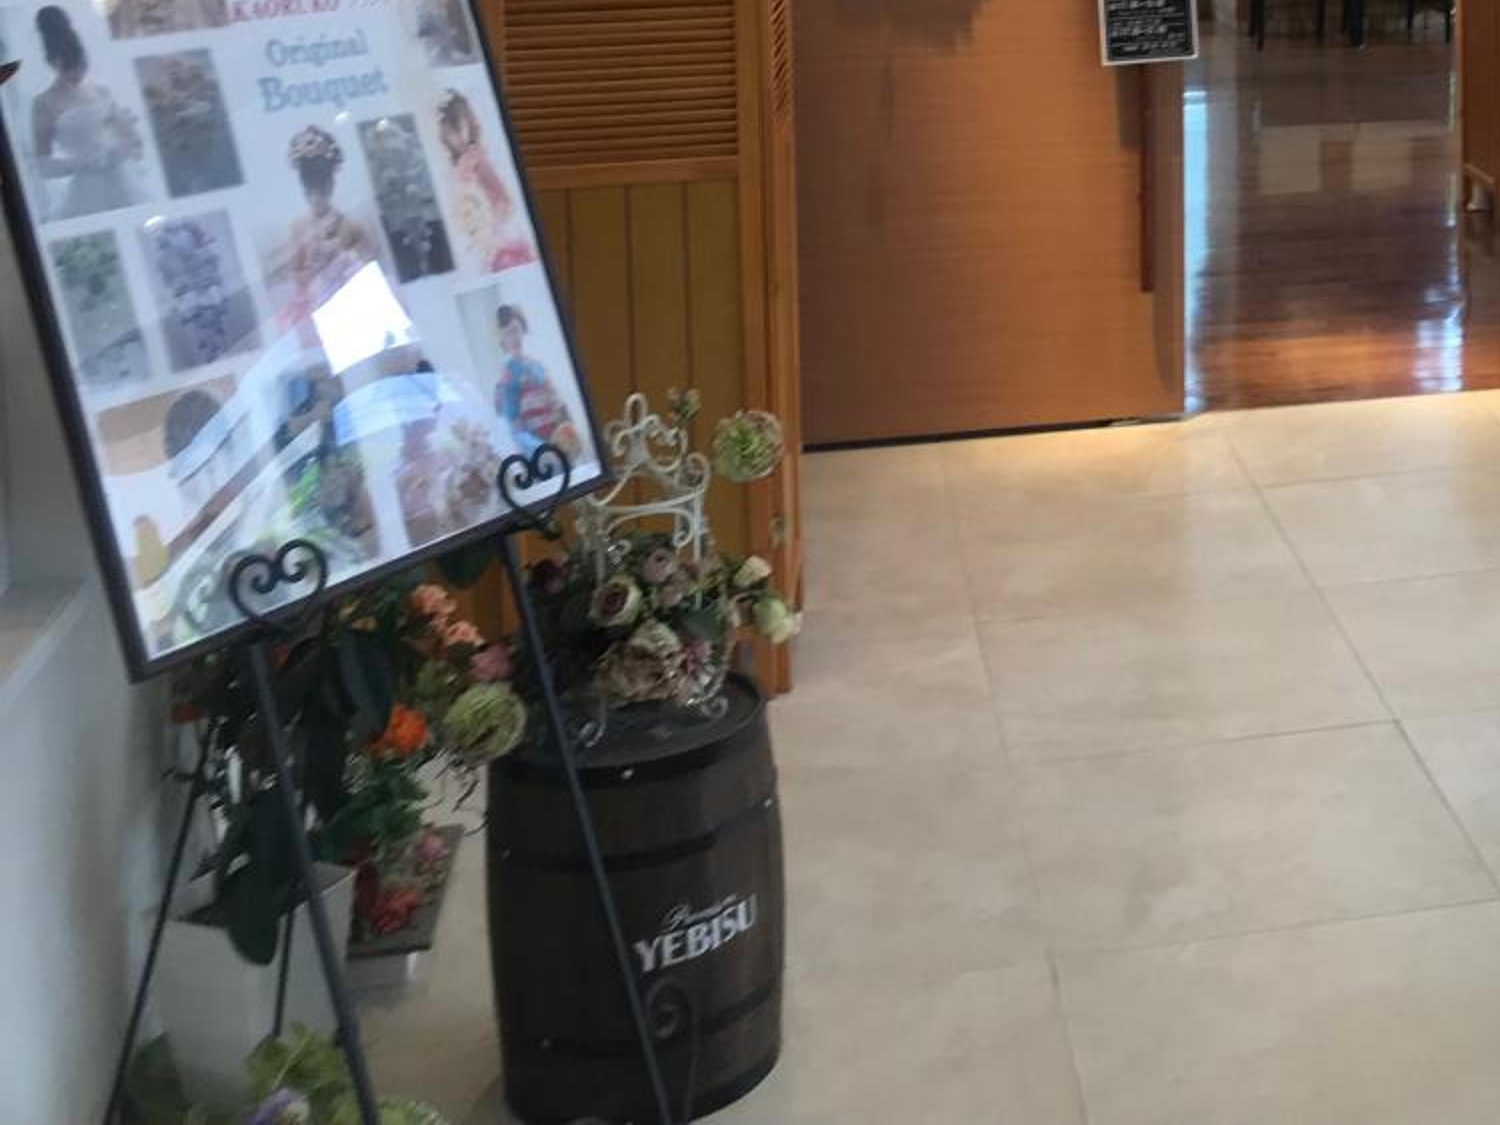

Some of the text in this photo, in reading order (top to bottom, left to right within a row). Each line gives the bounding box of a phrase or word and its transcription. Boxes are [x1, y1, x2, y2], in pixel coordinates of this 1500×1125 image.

[265, 28, 369, 68] Original
[258, 65, 388, 113] Bouquet
[633, 893, 758, 973] YEBISU
